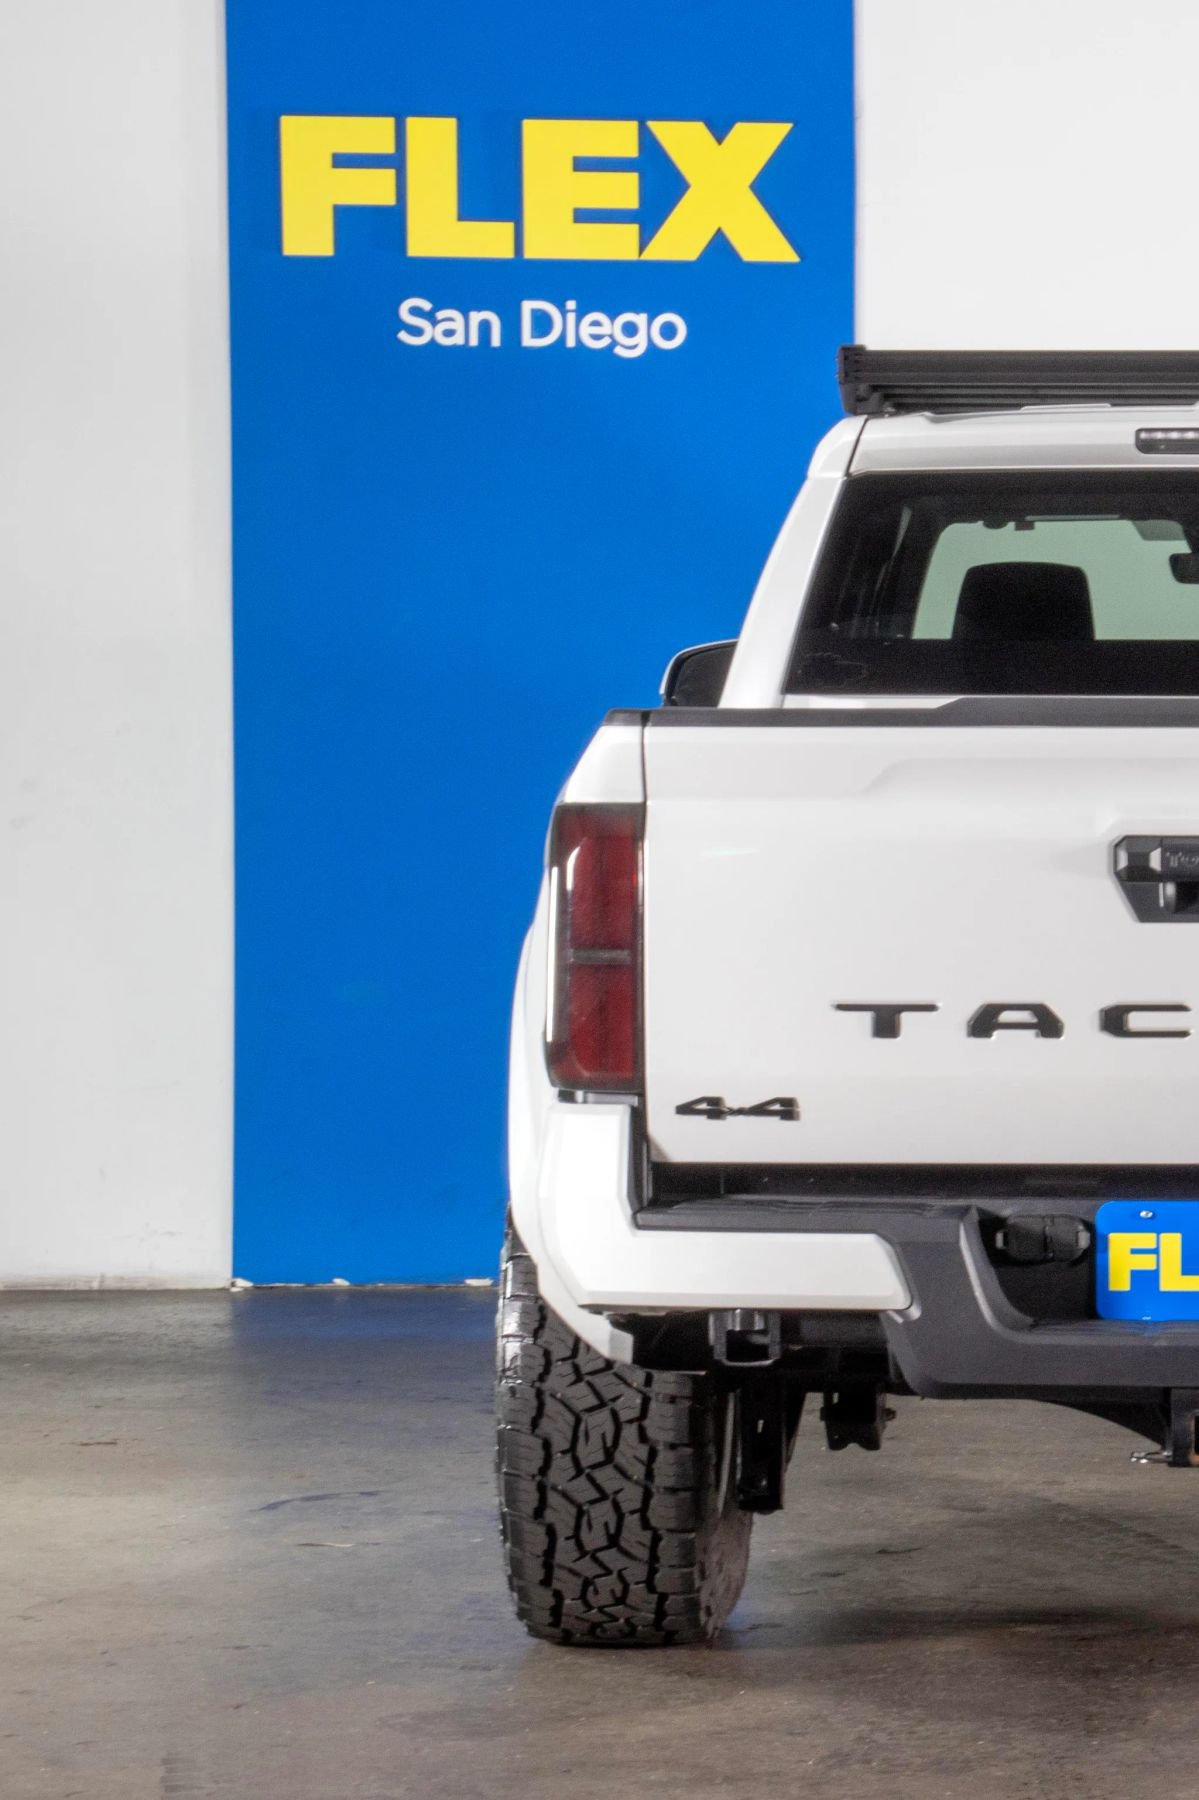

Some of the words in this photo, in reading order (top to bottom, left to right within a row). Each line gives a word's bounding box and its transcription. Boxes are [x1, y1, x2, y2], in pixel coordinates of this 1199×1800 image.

[280, 115, 800, 262] FLEX
[397, 297, 501, 347] San
[520, 299, 688, 359] Diego
